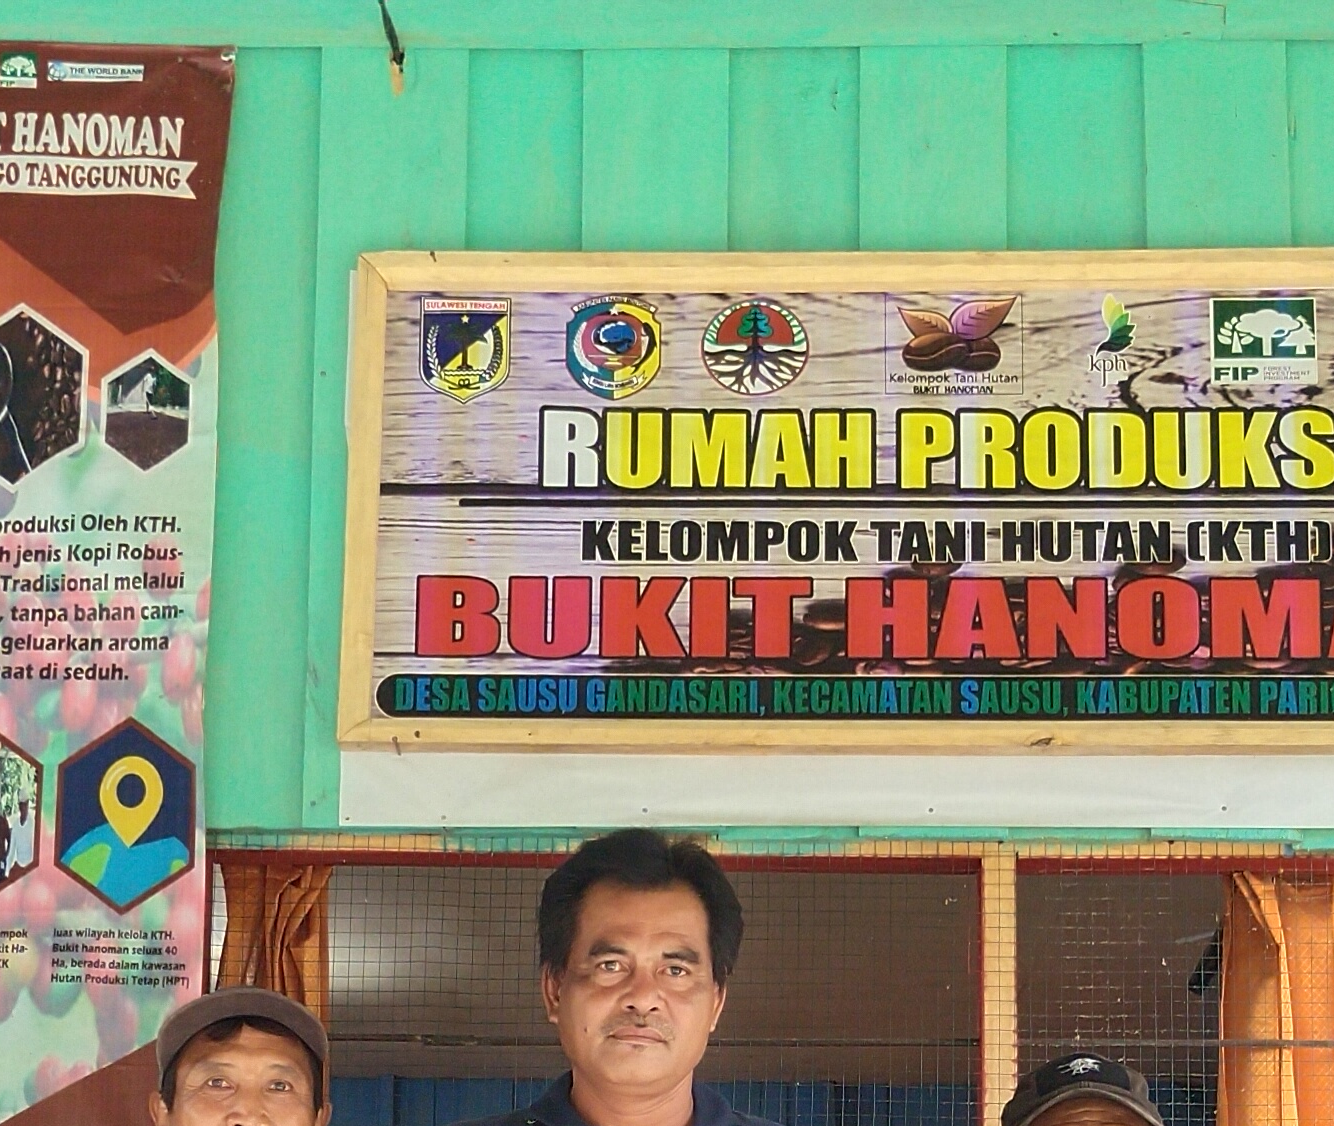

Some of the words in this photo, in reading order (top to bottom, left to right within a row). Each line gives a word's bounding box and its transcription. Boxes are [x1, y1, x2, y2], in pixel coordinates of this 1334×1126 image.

[14, 112, 184, 158] HANOMAN
[25, 164, 181, 189] TANGGUNUNG
[425, 301, 468, 310] SULAWESI
[469, 301, 507, 310] TENGAH
[889, 373, 951, 386] Kelompok
[954, 373, 978, 384] Tani
[982, 373, 1018, 384] Hutan
[1089, 354, 1128, 387] kph
[1214, 366, 1259, 381] FIP
[913, 385, 940, 394] BUKIT
[944, 385, 994, 394] HANOMAN
[540, 407, 875, 491] RUMAH
[81, 514, 128, 532] Oleh
[133, 516, 181, 533] KTH.
[581, 520, 858, 562] KELOMPOK
[869, 520, 986, 562] TANI
[1000, 520, 1173, 563] HUTAN
[1186, 520, 1333, 563] (KTH)
[13, 545, 62, 568] jenis
[67, 543, 111, 566] Kopi
[117, 543, 183, 561] Robus-
[0, 573, 109, 592] Tradisional
[114, 572, 184, 590] melalui
[11, 605, 67, 627] tanpa
[74, 604, 135, 622] bahan
[140, 604, 184, 620] cam-
[414, 574, 814, 660] BUKIT
[108, 635, 169, 651] aroma
[39, 662, 58, 680] di
[62, 662, 129, 681] seduh.
[394, 678, 471, 713] DESA
[477, 678, 577, 715] SAUSU
[586, 678, 766, 716] GANDASARI,
[773, 677, 952, 715] KECAMATAN
[960, 678, 1069, 716] SAUSU,
[1075, 677, 1251, 716] KABUPATEN
[150, 931, 175, 941] KTH.
[52, 943, 79, 953] Bukit
[81, 944, 129, 954] hanoman
[132, 946, 163, 956] seluas
[165, 946, 178, 956] 40
[51, 958, 68, 969] Ha,
[71, 958, 106, 969] berada
[108, 960, 139, 970] dalam
[142, 960, 186, 971] kawasan
[50, 973, 82, 983] Hutan
[85, 974, 129, 985] Produksi
[131, 976, 160, 988] Tetap
[162, 976, 190, 989] (HPT)
